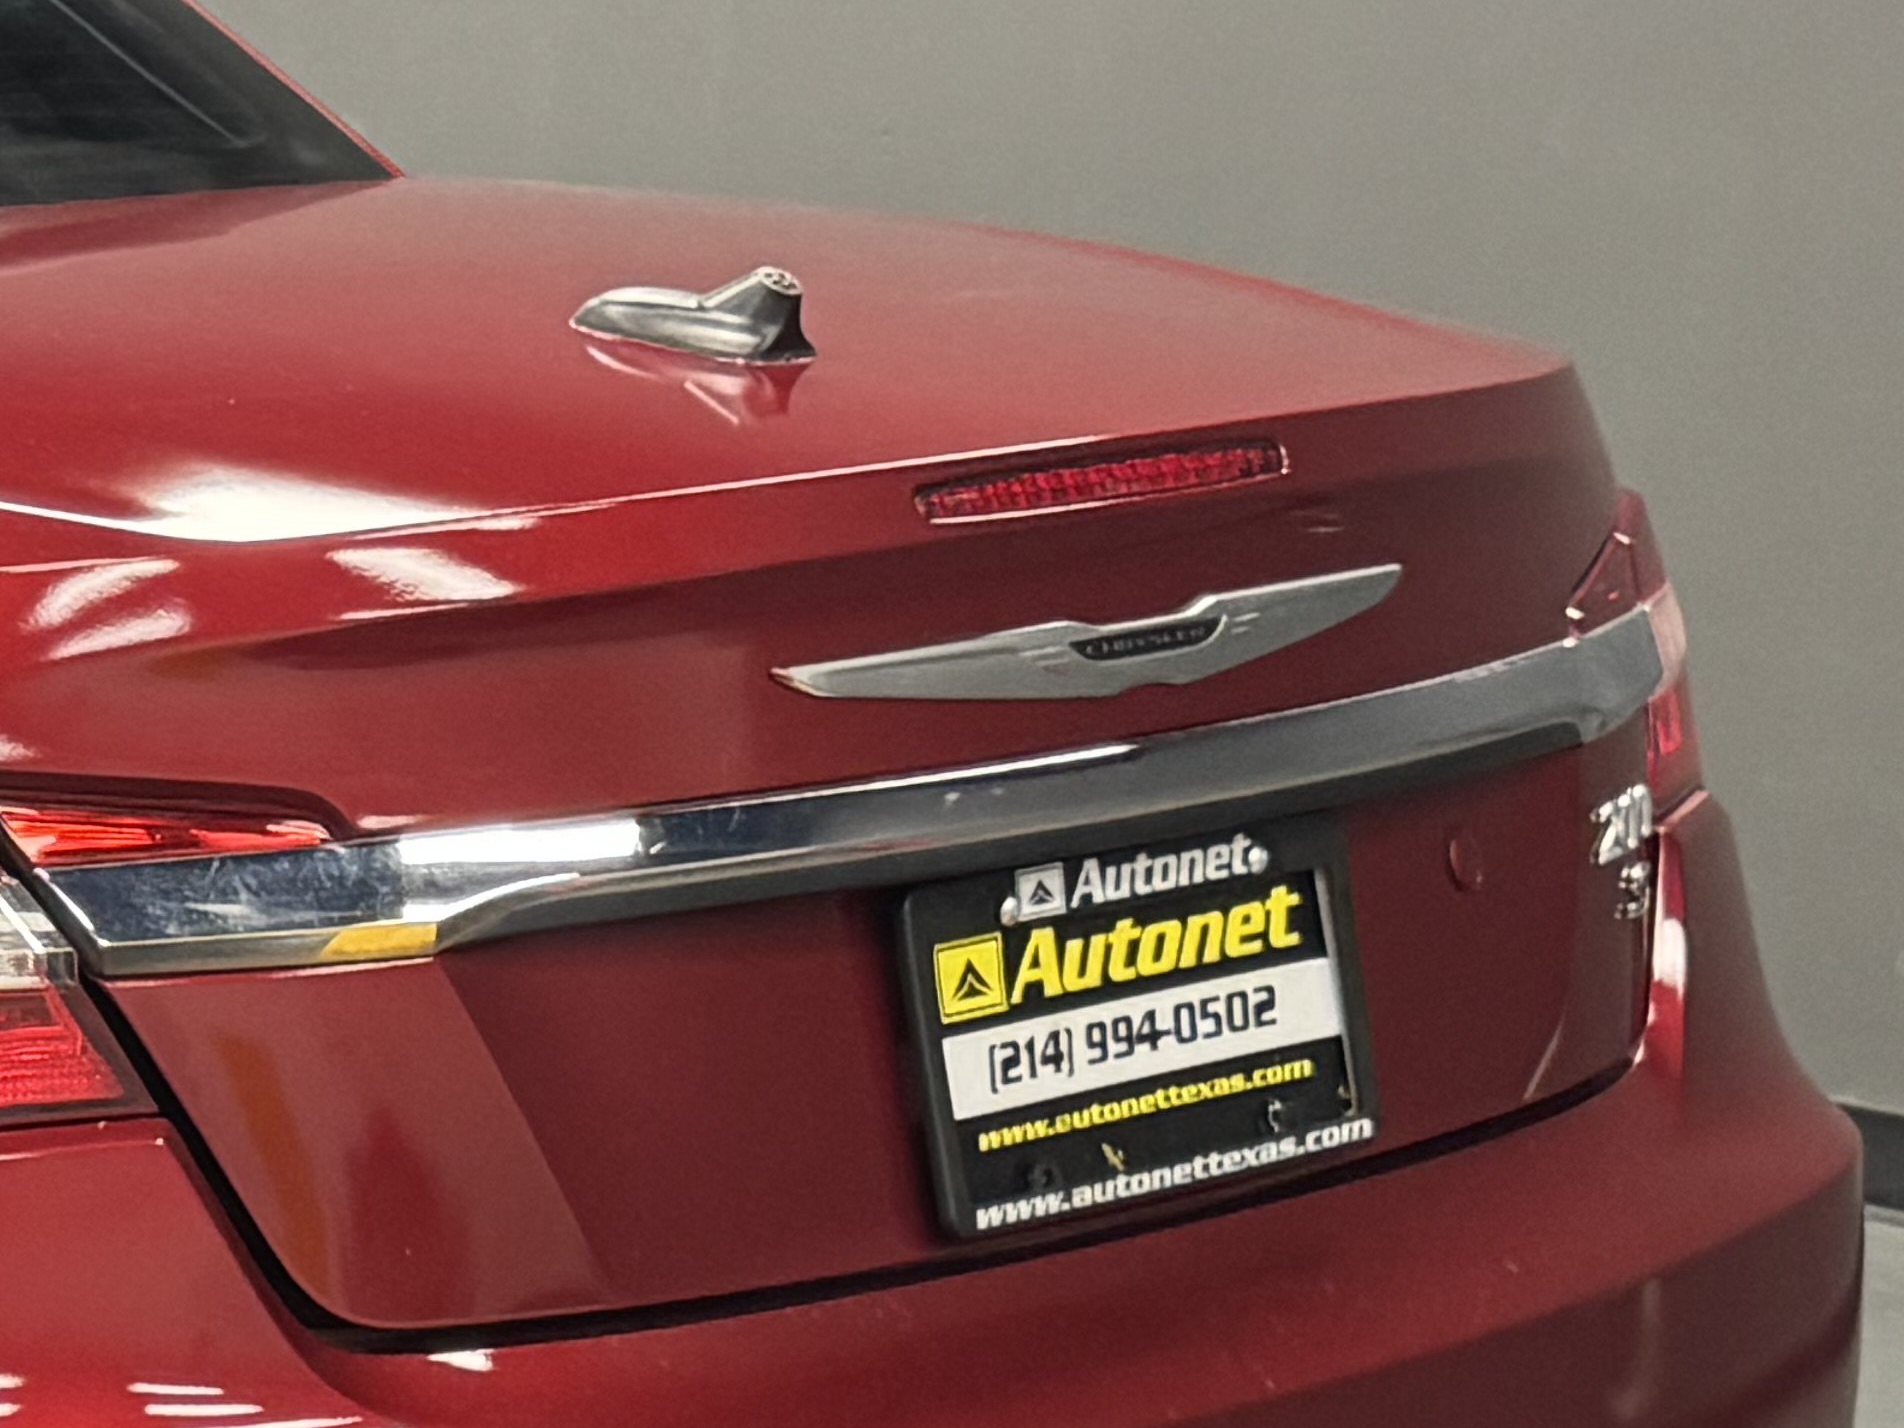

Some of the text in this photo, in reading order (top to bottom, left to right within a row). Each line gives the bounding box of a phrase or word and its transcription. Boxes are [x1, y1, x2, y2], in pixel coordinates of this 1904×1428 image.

[1071, 833, 1250, 908] Autonet
[1012, 885, 1302, 1003] Autonet
[988, 985, 1278, 1094] (214) 994-0502
[978, 1058, 1313, 1152] www.autonettexas.com
[977, 1118, 1372, 1230] www.autonettexas.com
